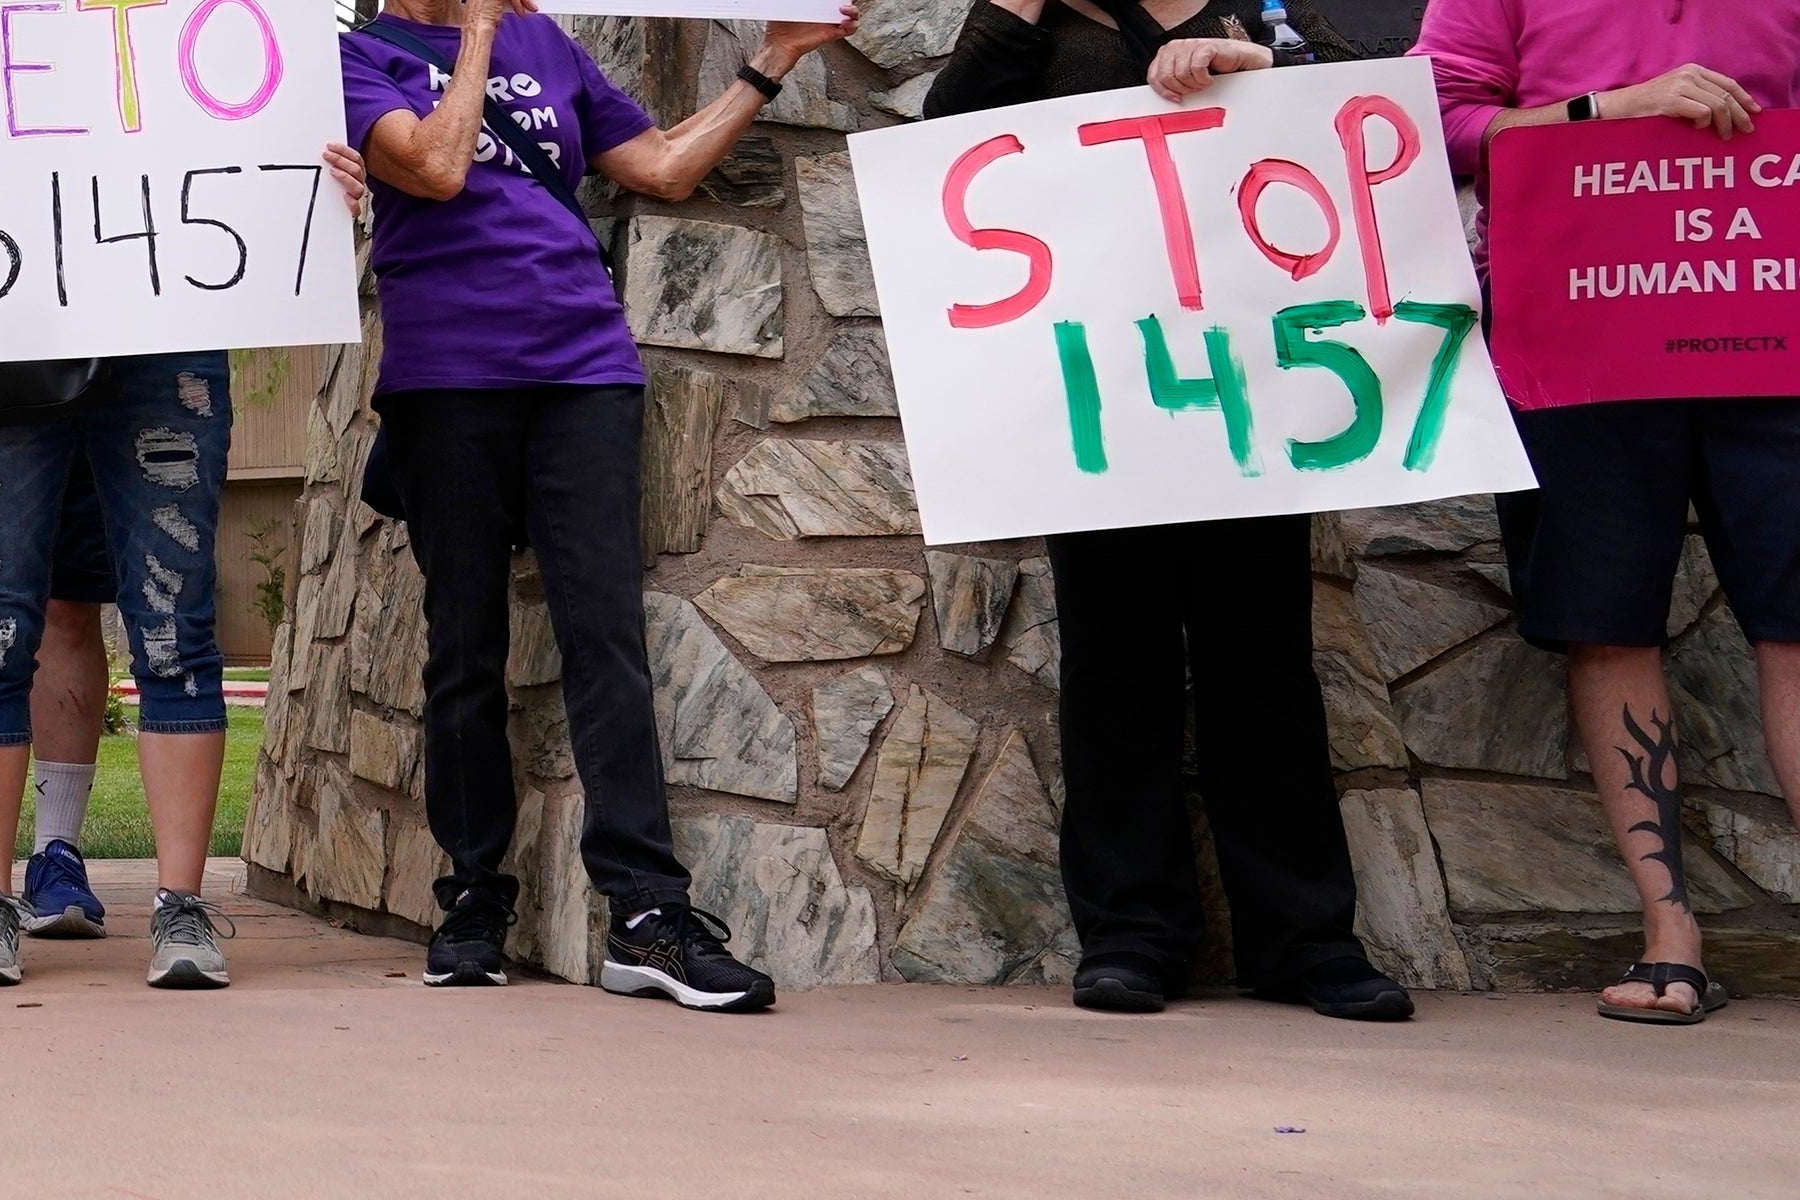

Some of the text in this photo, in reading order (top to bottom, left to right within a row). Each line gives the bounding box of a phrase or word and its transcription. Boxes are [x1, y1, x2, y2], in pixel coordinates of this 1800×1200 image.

[1573, 156, 1735, 198] HEALTH
[941, 94, 1421, 328] STOP
[1675, 207, 1763, 242] IS A
[1569, 259, 1737, 300] HUMAN
[1664, 335, 1788, 355] #PROTECTX
[1054, 298, 1480, 478] 1457
